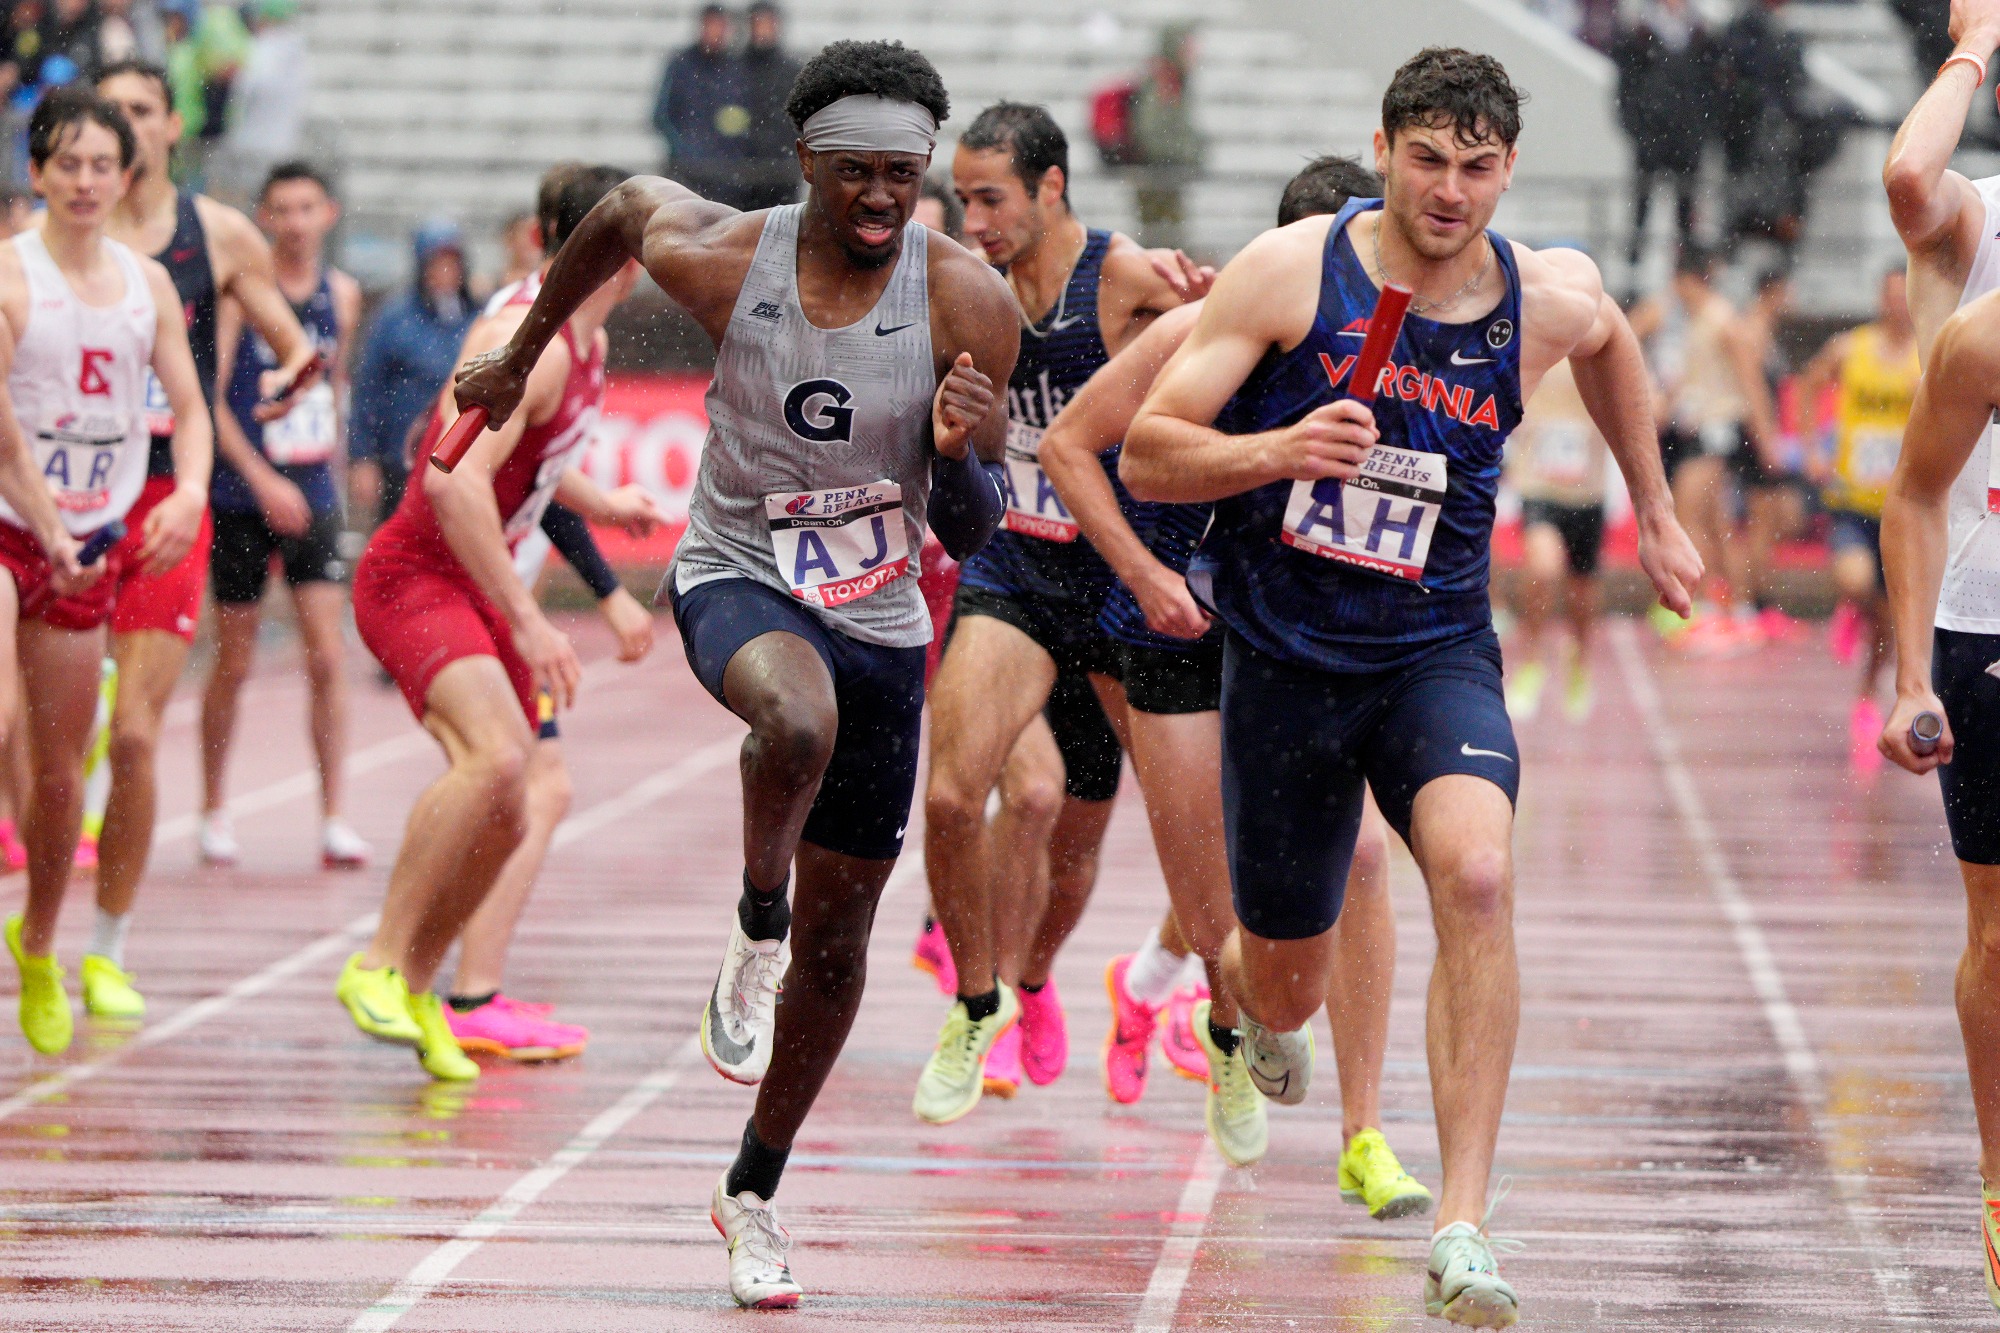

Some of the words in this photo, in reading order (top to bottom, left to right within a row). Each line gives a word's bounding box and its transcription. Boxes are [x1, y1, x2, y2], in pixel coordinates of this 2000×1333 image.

[752, 308, 783, 320] EAST
[756, 302, 779, 311] BIG
[1318, 352, 1499, 431] VRGINIA
[782, 377, 859, 445] G
[1369, 448, 1421, 468] PENN
[1364, 460, 1431, 482] RELAYS
[822, 493, 883, 514] RELAYS
[823, 487, 868, 504] PENN
[791, 519, 826, 527] Dream
[824, 566, 898, 602] TOYOTA
